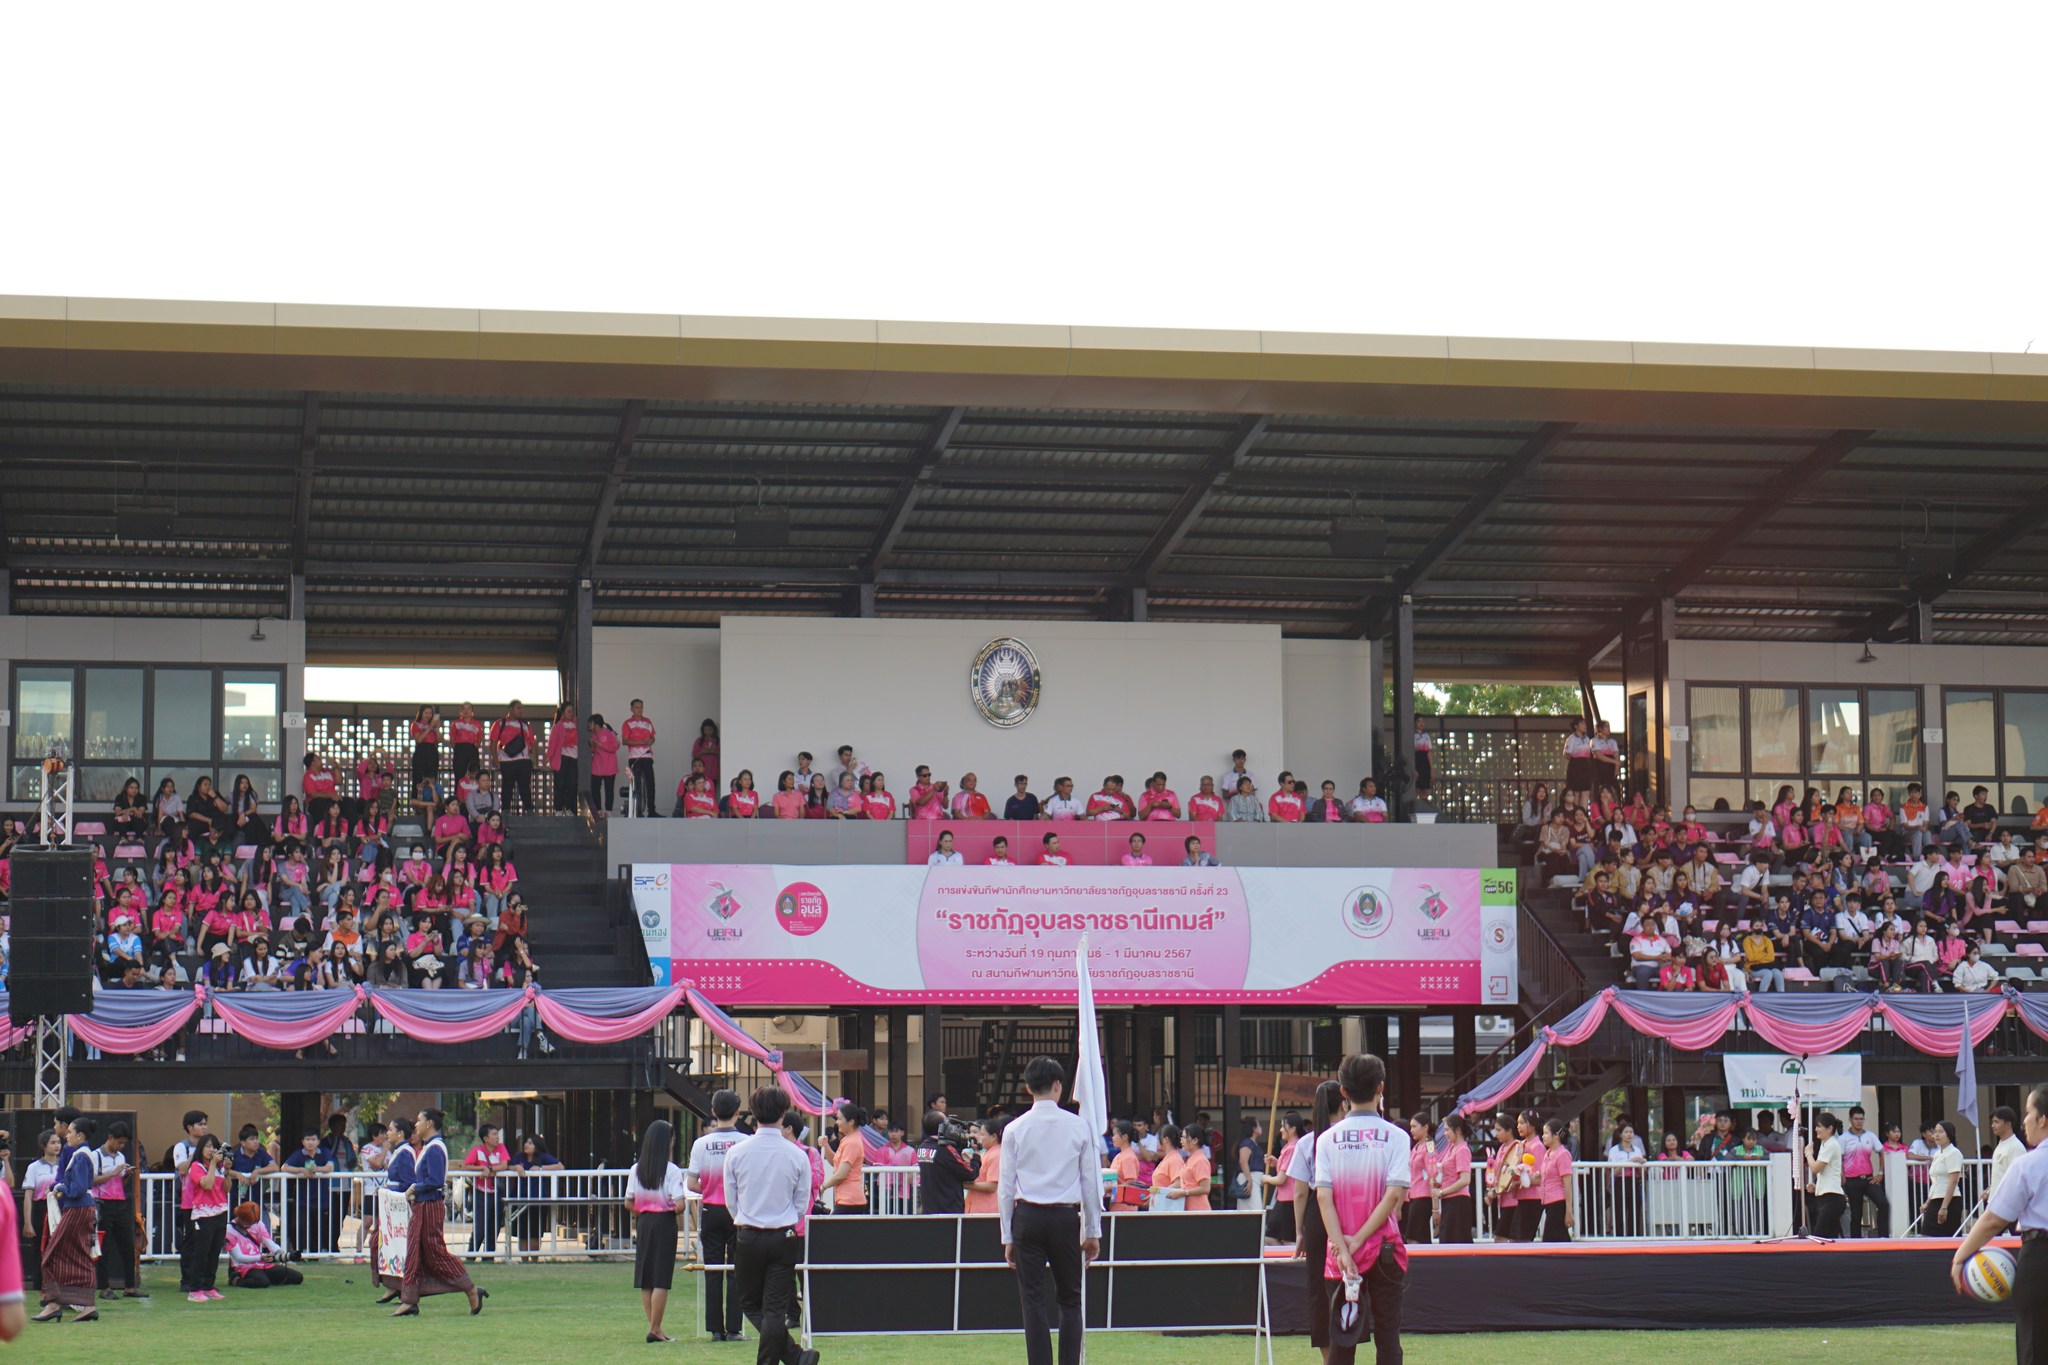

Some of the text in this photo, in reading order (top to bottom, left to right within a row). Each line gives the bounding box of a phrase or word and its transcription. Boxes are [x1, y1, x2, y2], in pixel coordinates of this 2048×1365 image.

[937, 883, 1229, 898] การแข่งขันกีฬานักศึกษามหาวิทยาลัยราชภัฏอุบลราชธานี ครั้งที่ 23
[1498, 881, 1513, 893] 5G
[936, 907, 1226, 938] “ราชภัฏอุบลราชธานีเกมส์”
[707, 928, 742, 937] UBRU
[1417, 928, 1450, 937] UBRU
[966, 944, 1027, 958] ระหว่างวันที่
[1030, 949, 1044, 958] 19
[1047, 946, 1102, 962] กุมภานธ์
[1124, 947, 1161, 958] มีนาคม
[1164, 949, 1192, 958] 2567
[971, 970, 982, 978] ณ
[1333, 1128, 1390, 1144] UBRU
[706, 1140, 736, 1151] UBR
[1338, 1142, 1369, 1150] GAMES
[917, 1148, 937, 1159] UBRU
[1982, 1259, 2007, 1294] MIKASA
